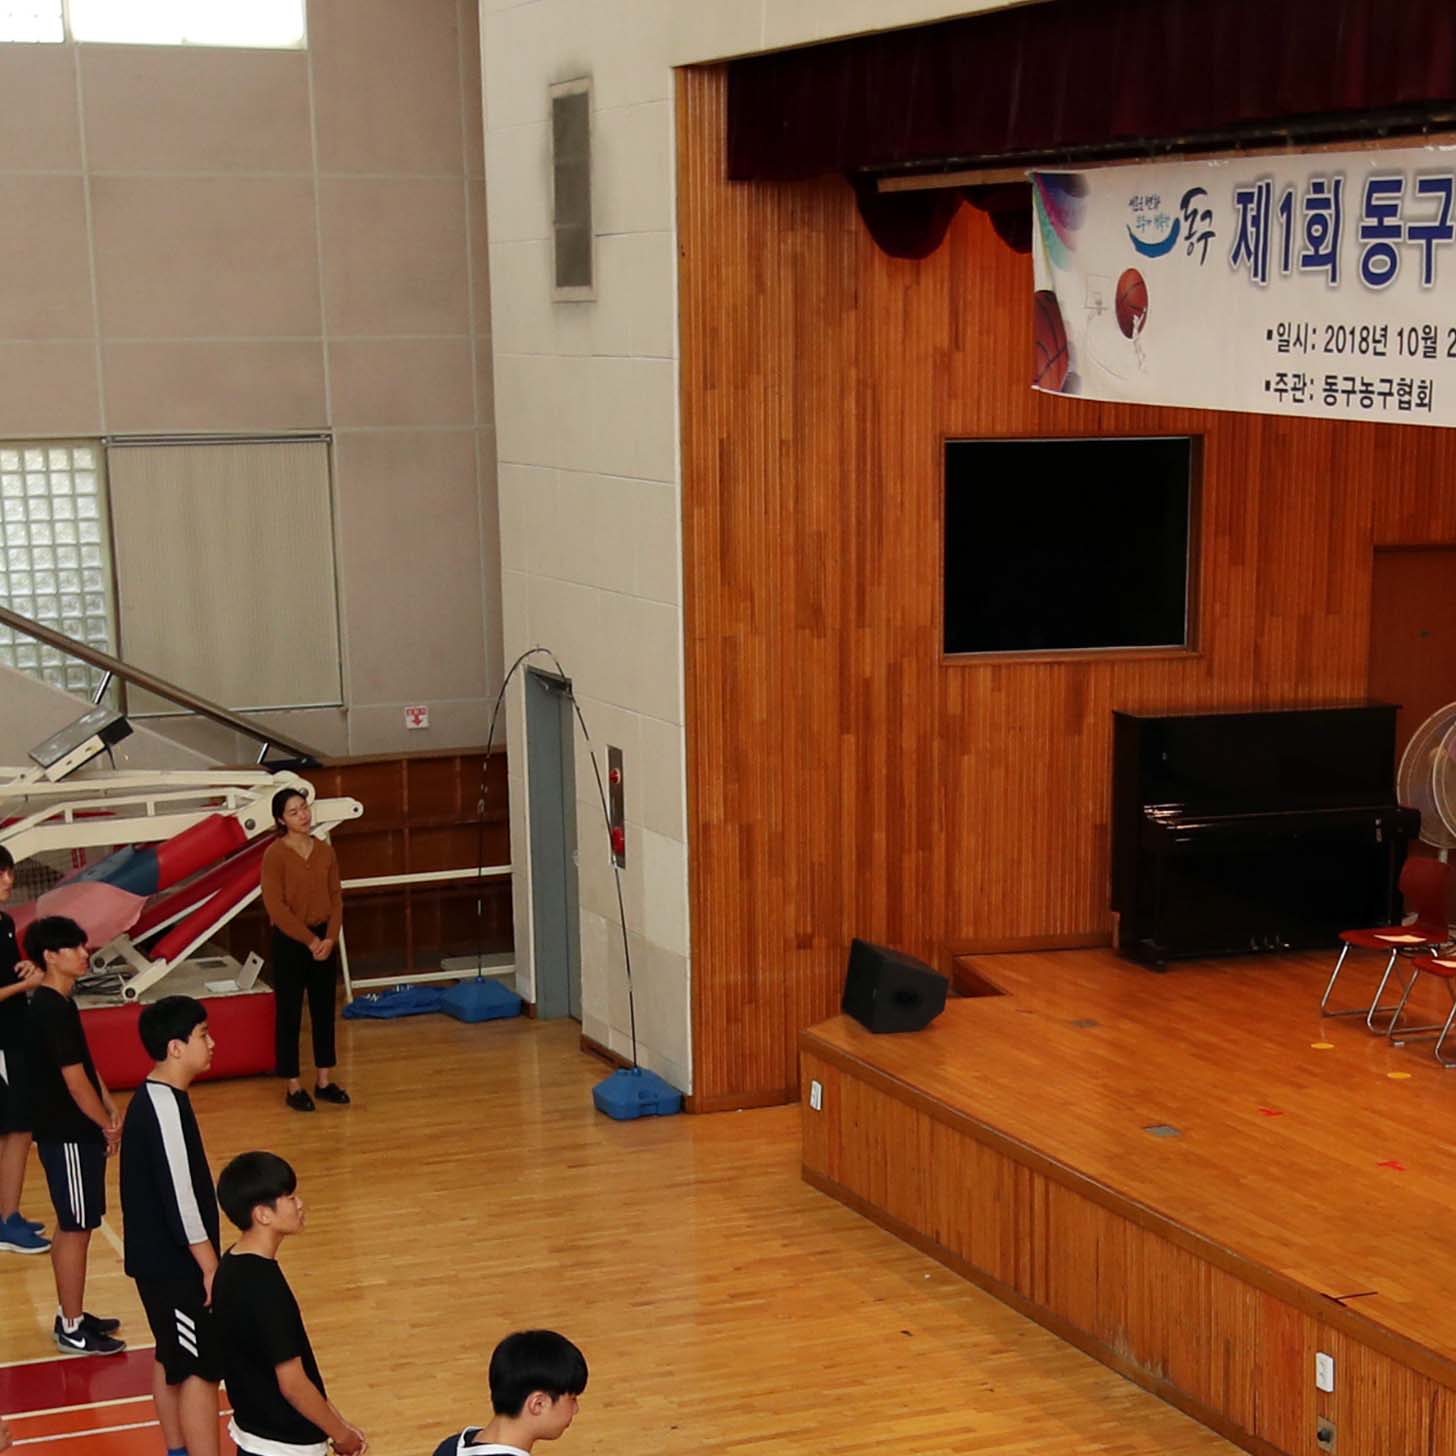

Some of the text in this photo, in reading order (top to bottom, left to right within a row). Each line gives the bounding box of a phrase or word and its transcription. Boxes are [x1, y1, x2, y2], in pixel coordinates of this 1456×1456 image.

[1231, 178, 1343, 285] 제1회
[1276, 322, 1317, 354] 일시:
[1324, 323, 1388, 357] 2018년
[1396, 324, 1439, 359] 10월
[1273, 372, 1434, 412] 주관: 동구농구협회
